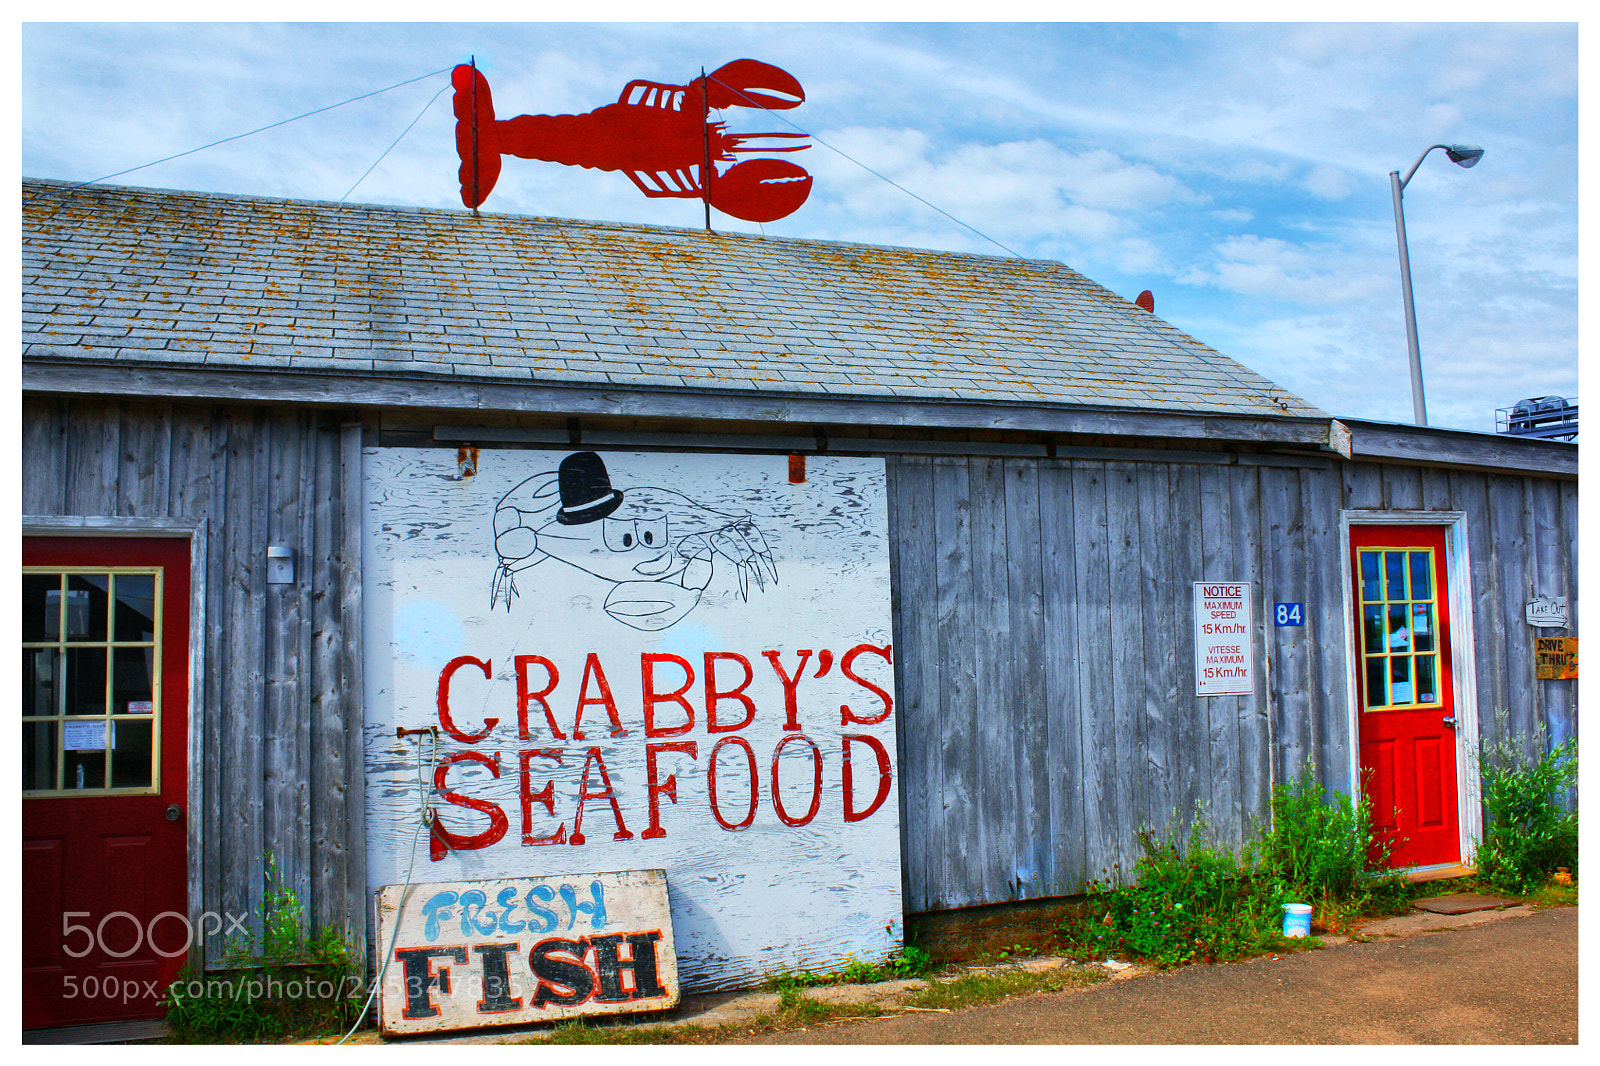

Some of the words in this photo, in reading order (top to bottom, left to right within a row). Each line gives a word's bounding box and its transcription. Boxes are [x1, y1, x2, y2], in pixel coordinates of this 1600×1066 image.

[1203, 585, 1242, 597] NOTICE
[1204, 601, 1243, 610] MAXIMUM
[1210, 610, 1237, 620] SPEED
[1277, 604, 1301, 625] 84
[1202, 623, 1213, 634] 15
[1208, 645, 1241, 654] VITESSE
[1537, 639, 1563, 652] DRIVE
[1206, 655, 1244, 664] MAXIMUM
[1539, 653, 1567, 666] THRU
[1203, 667, 1214, 679] 15
[436, 643, 894, 744] CRABBY'S
[429, 733, 893, 861] SEAFOOD
[422, 880, 607, 942] FRESH
[394, 928, 670, 1020] FISH
